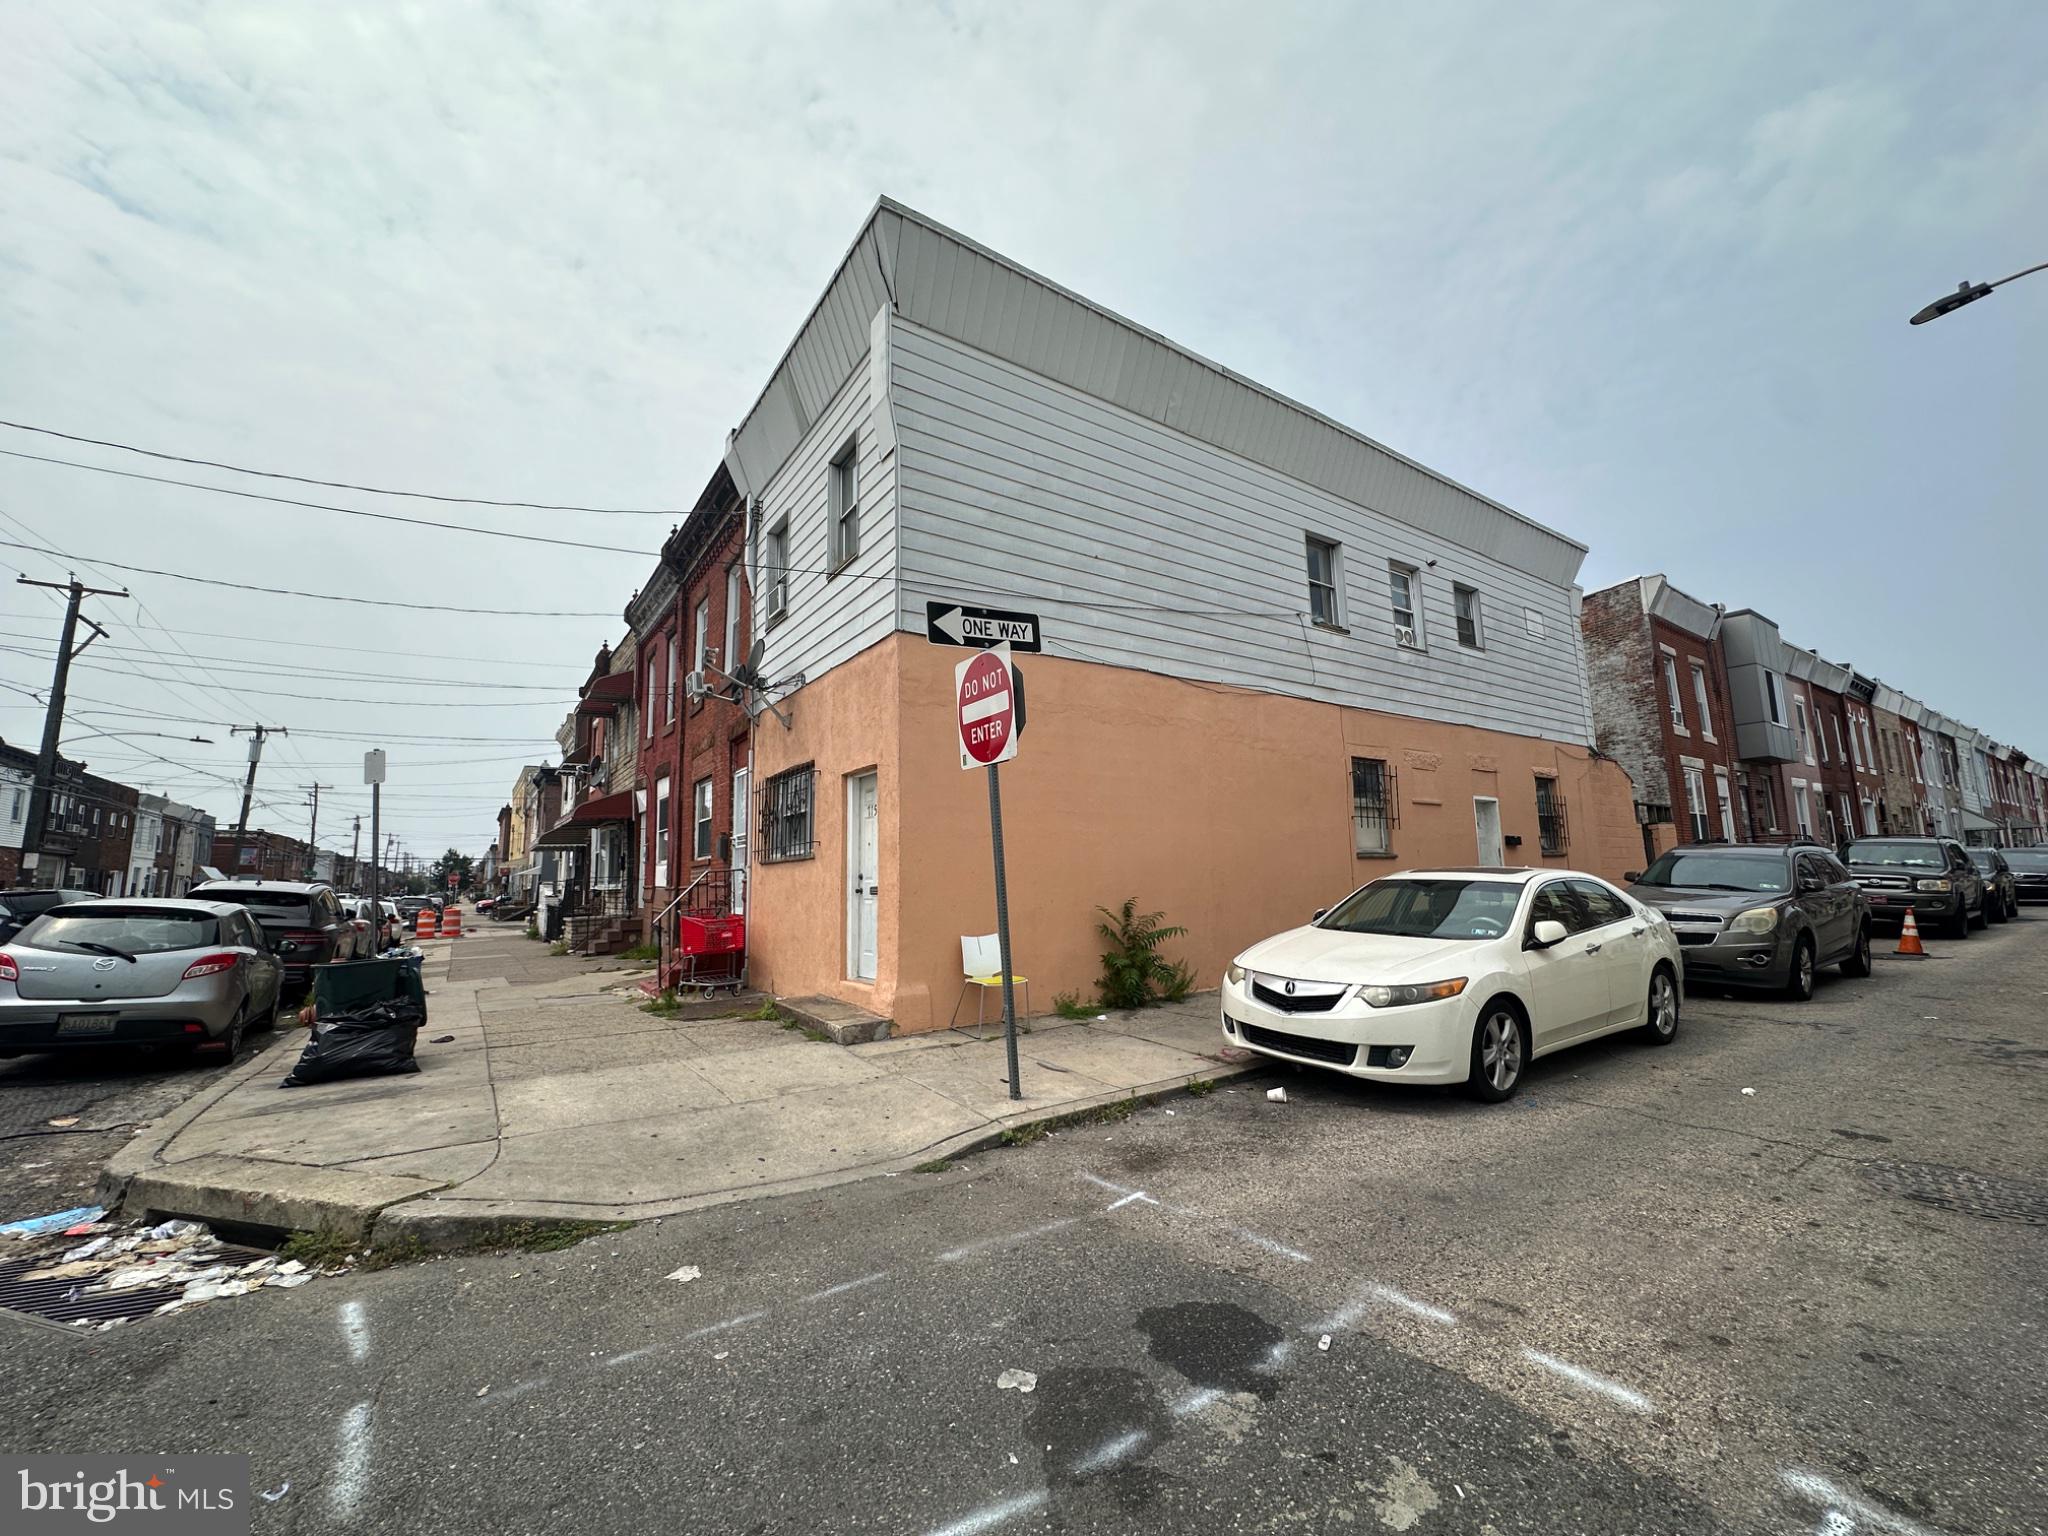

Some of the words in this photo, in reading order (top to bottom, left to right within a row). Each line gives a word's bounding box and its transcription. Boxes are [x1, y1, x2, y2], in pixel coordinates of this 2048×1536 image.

[962, 618, 993, 637] ONE
[998, 622, 1028, 640] WAY
[964, 679, 978, 699] DO
[982, 668, 1003, 690] NOT
[971, 720, 1003, 745] ENTER
